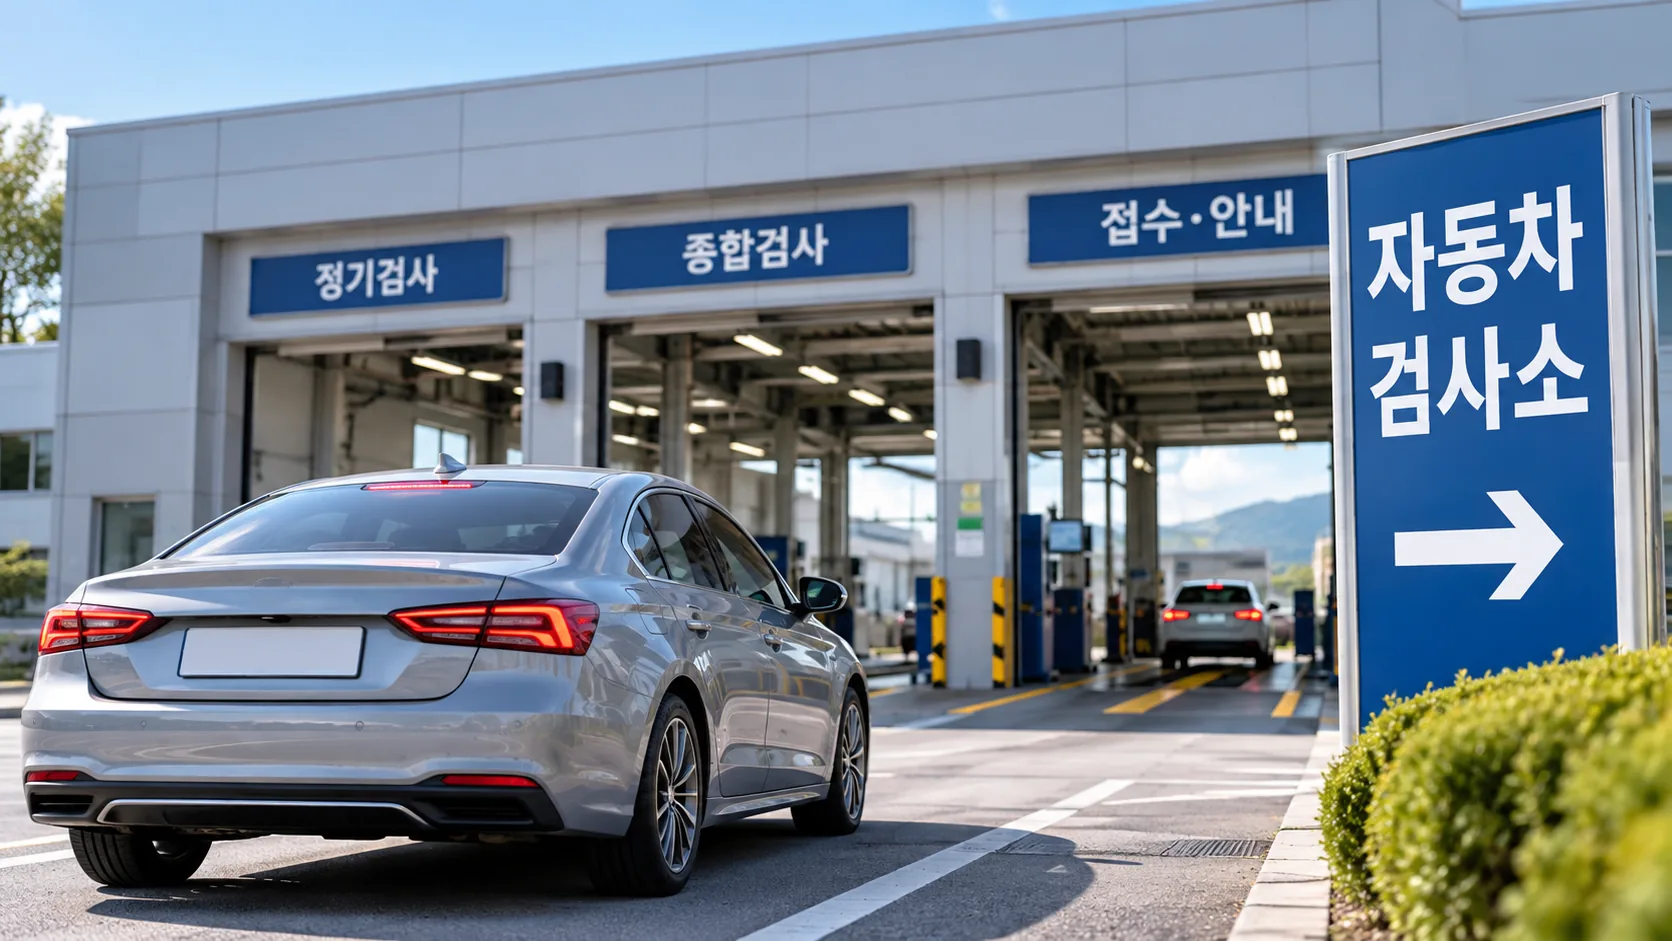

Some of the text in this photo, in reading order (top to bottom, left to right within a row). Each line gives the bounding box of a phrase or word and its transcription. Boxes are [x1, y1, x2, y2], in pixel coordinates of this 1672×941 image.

[315, 254, 439, 301] 정기검사
[682, 223, 829, 275] 종합검사
[1367, 184, 1584, 312] 자동차
[1370, 322, 1589, 438] 검사소
